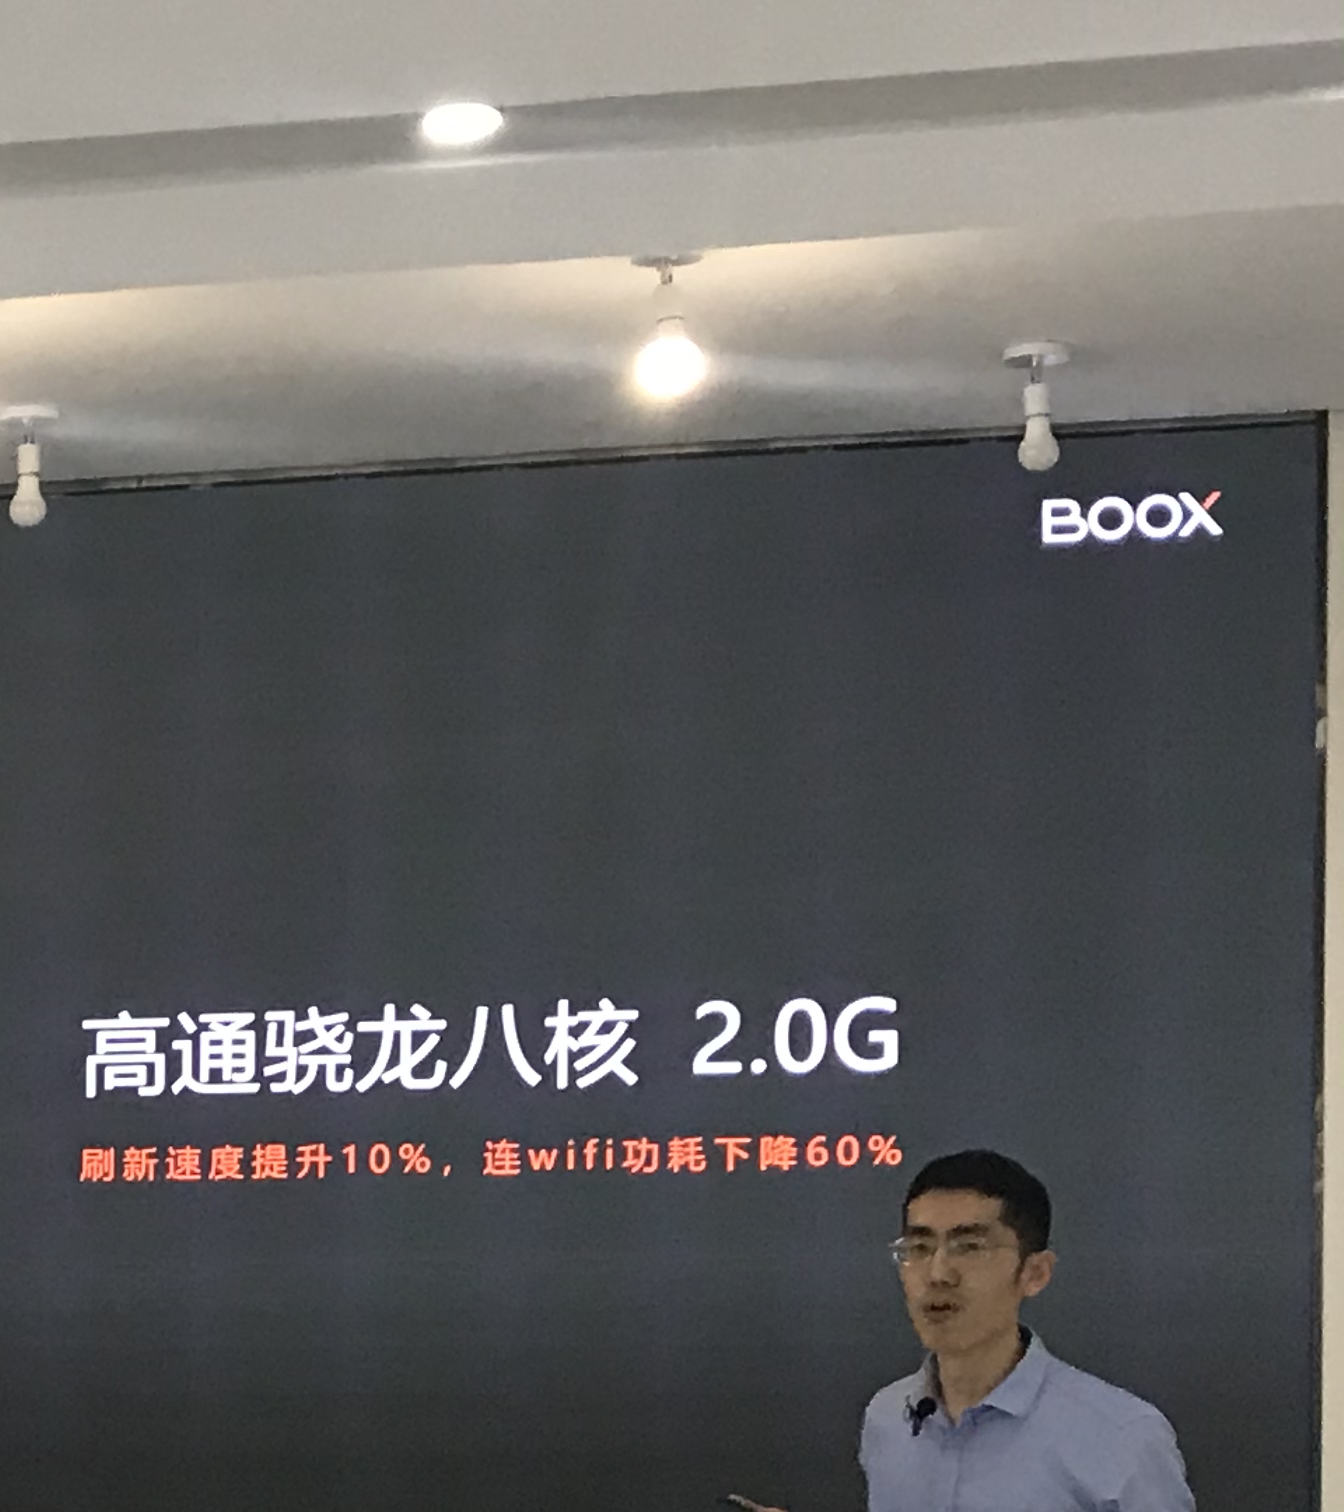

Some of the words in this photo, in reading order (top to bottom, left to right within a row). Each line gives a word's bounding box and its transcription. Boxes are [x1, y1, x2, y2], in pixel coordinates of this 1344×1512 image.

[1041, 490, 1224, 544] BOOX
[80, 996, 640, 1099] 高通骁龙八核
[691, 995, 901, 1078] 2.0G
